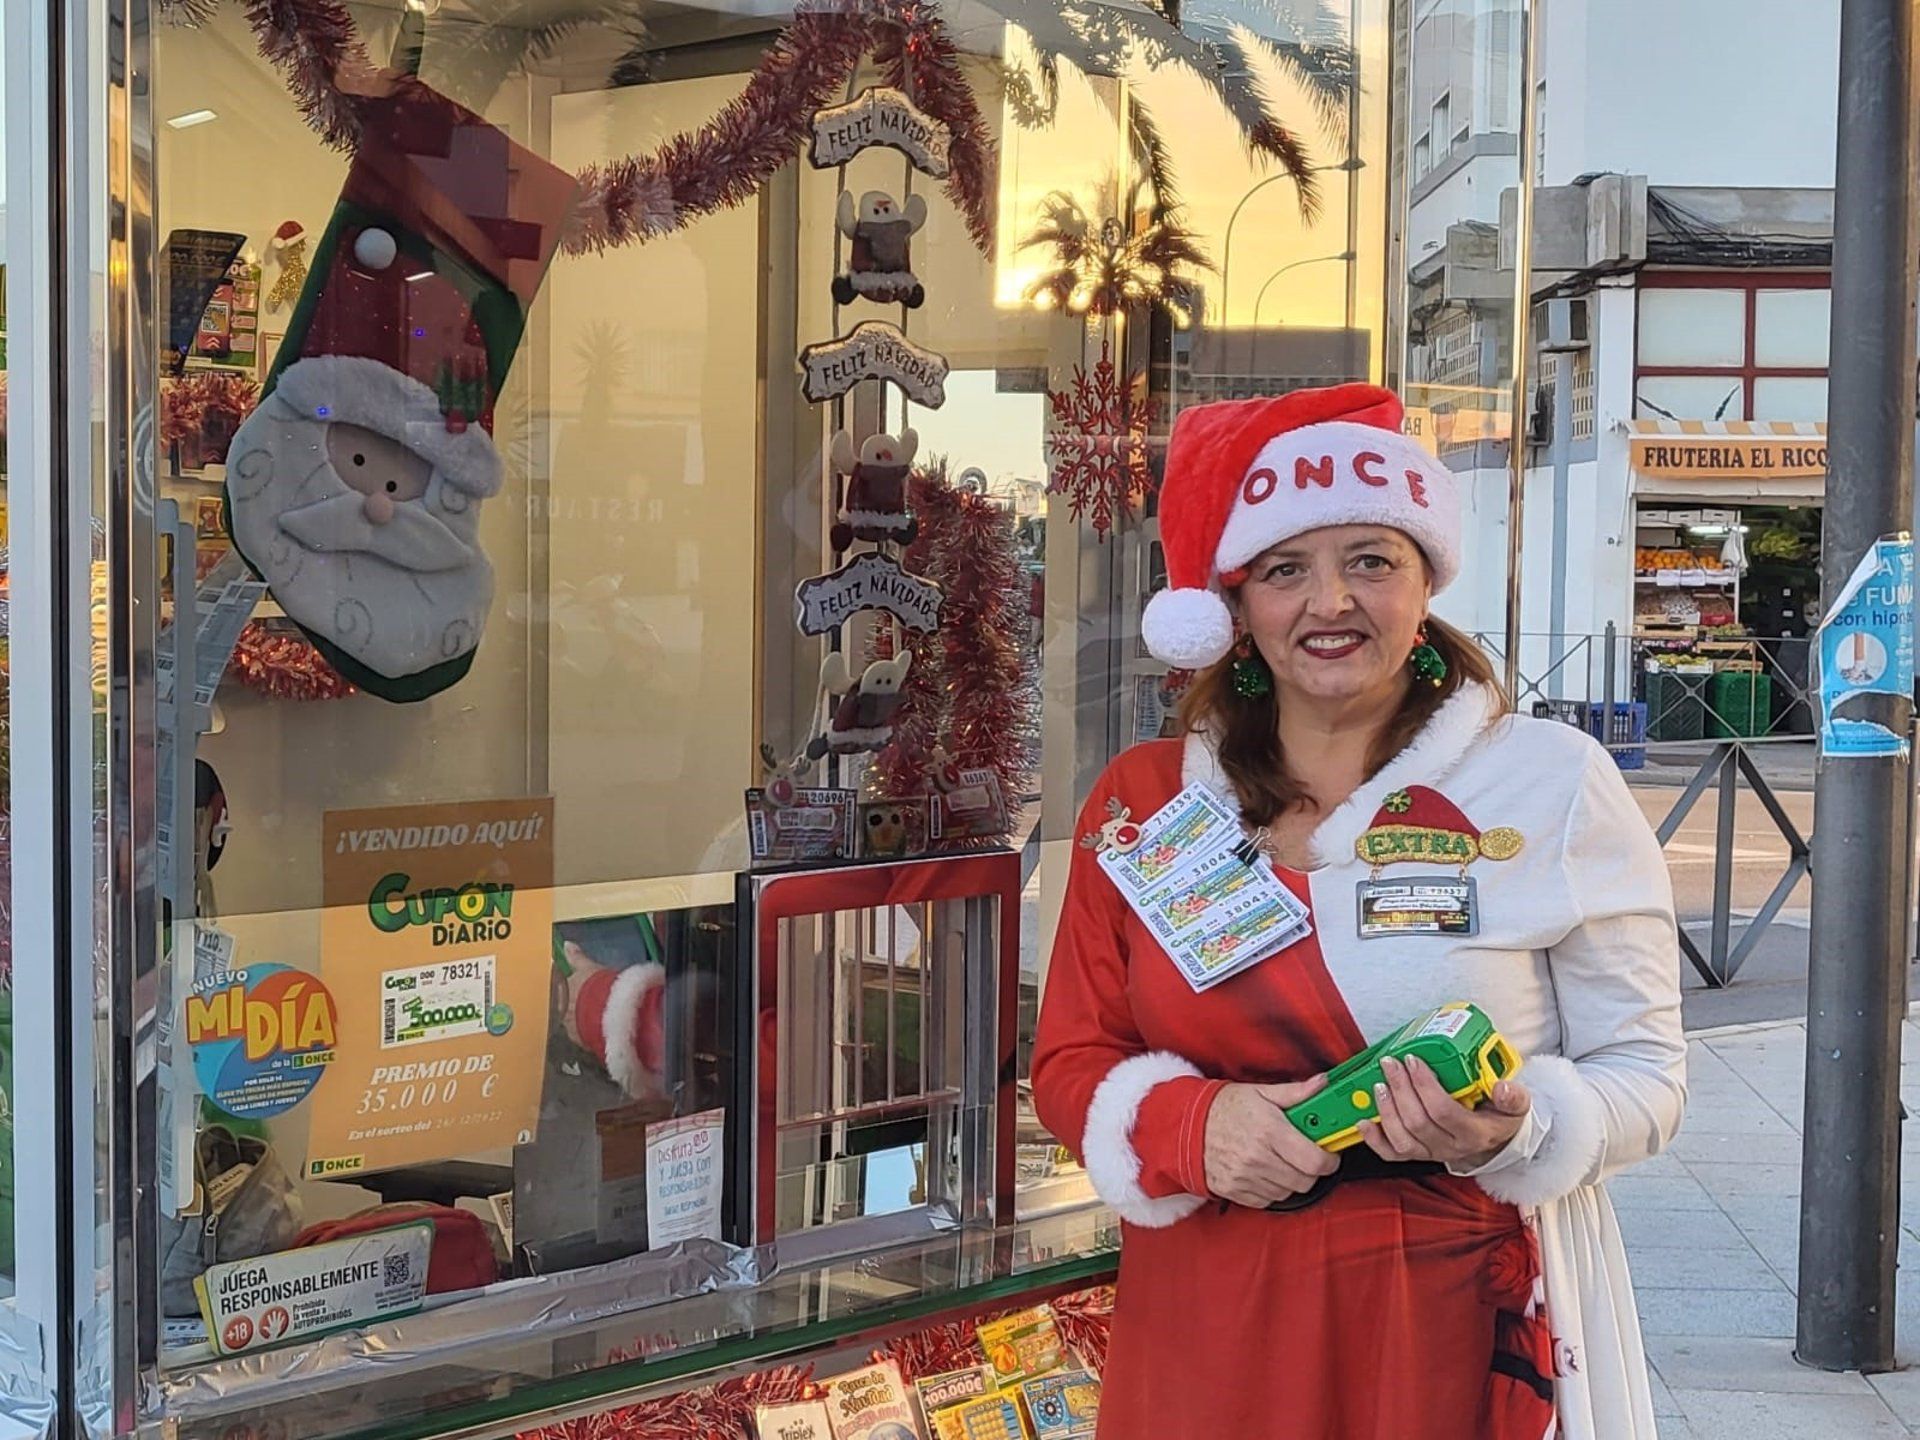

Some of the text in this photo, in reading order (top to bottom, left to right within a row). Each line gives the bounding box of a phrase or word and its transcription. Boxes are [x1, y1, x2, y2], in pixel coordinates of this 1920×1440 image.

[828, 110, 941, 156] FELIZ NAVIDAD
[822, 344, 935, 388] FELIZ NAVIDAD
[1643, 446, 1745, 468] FRUTERIA
[1751, 448, 1775, 468] EL
[1243, 451, 1429, 508] ONCE
[820, 575, 931, 617] FELIZ NAVIDAD
[1154, 792, 1192, 826] 71239
[336, 812, 544, 854] ¡VENDIDO AQUÍ!
[1366, 831, 1470, 856] EXTRA
[1225, 890, 1270, 918] 38043
[192, 969, 249, 994] NUEVO
[442, 961, 480, 981] 78321
[187, 981, 336, 1061] MI DÍA
[305, 1052, 335, 1065] ONCE
[370, 1054, 495, 1086] PREMIO DE
[325, 1157, 361, 1172] ONCE
[219, 1266, 268, 1295] JUEGA
[221, 1260, 378, 1315] RESPONSABLEMENTE
[226, 1322, 248, 1341] +18
[925, 1376, 983, 1407] 100.000€
